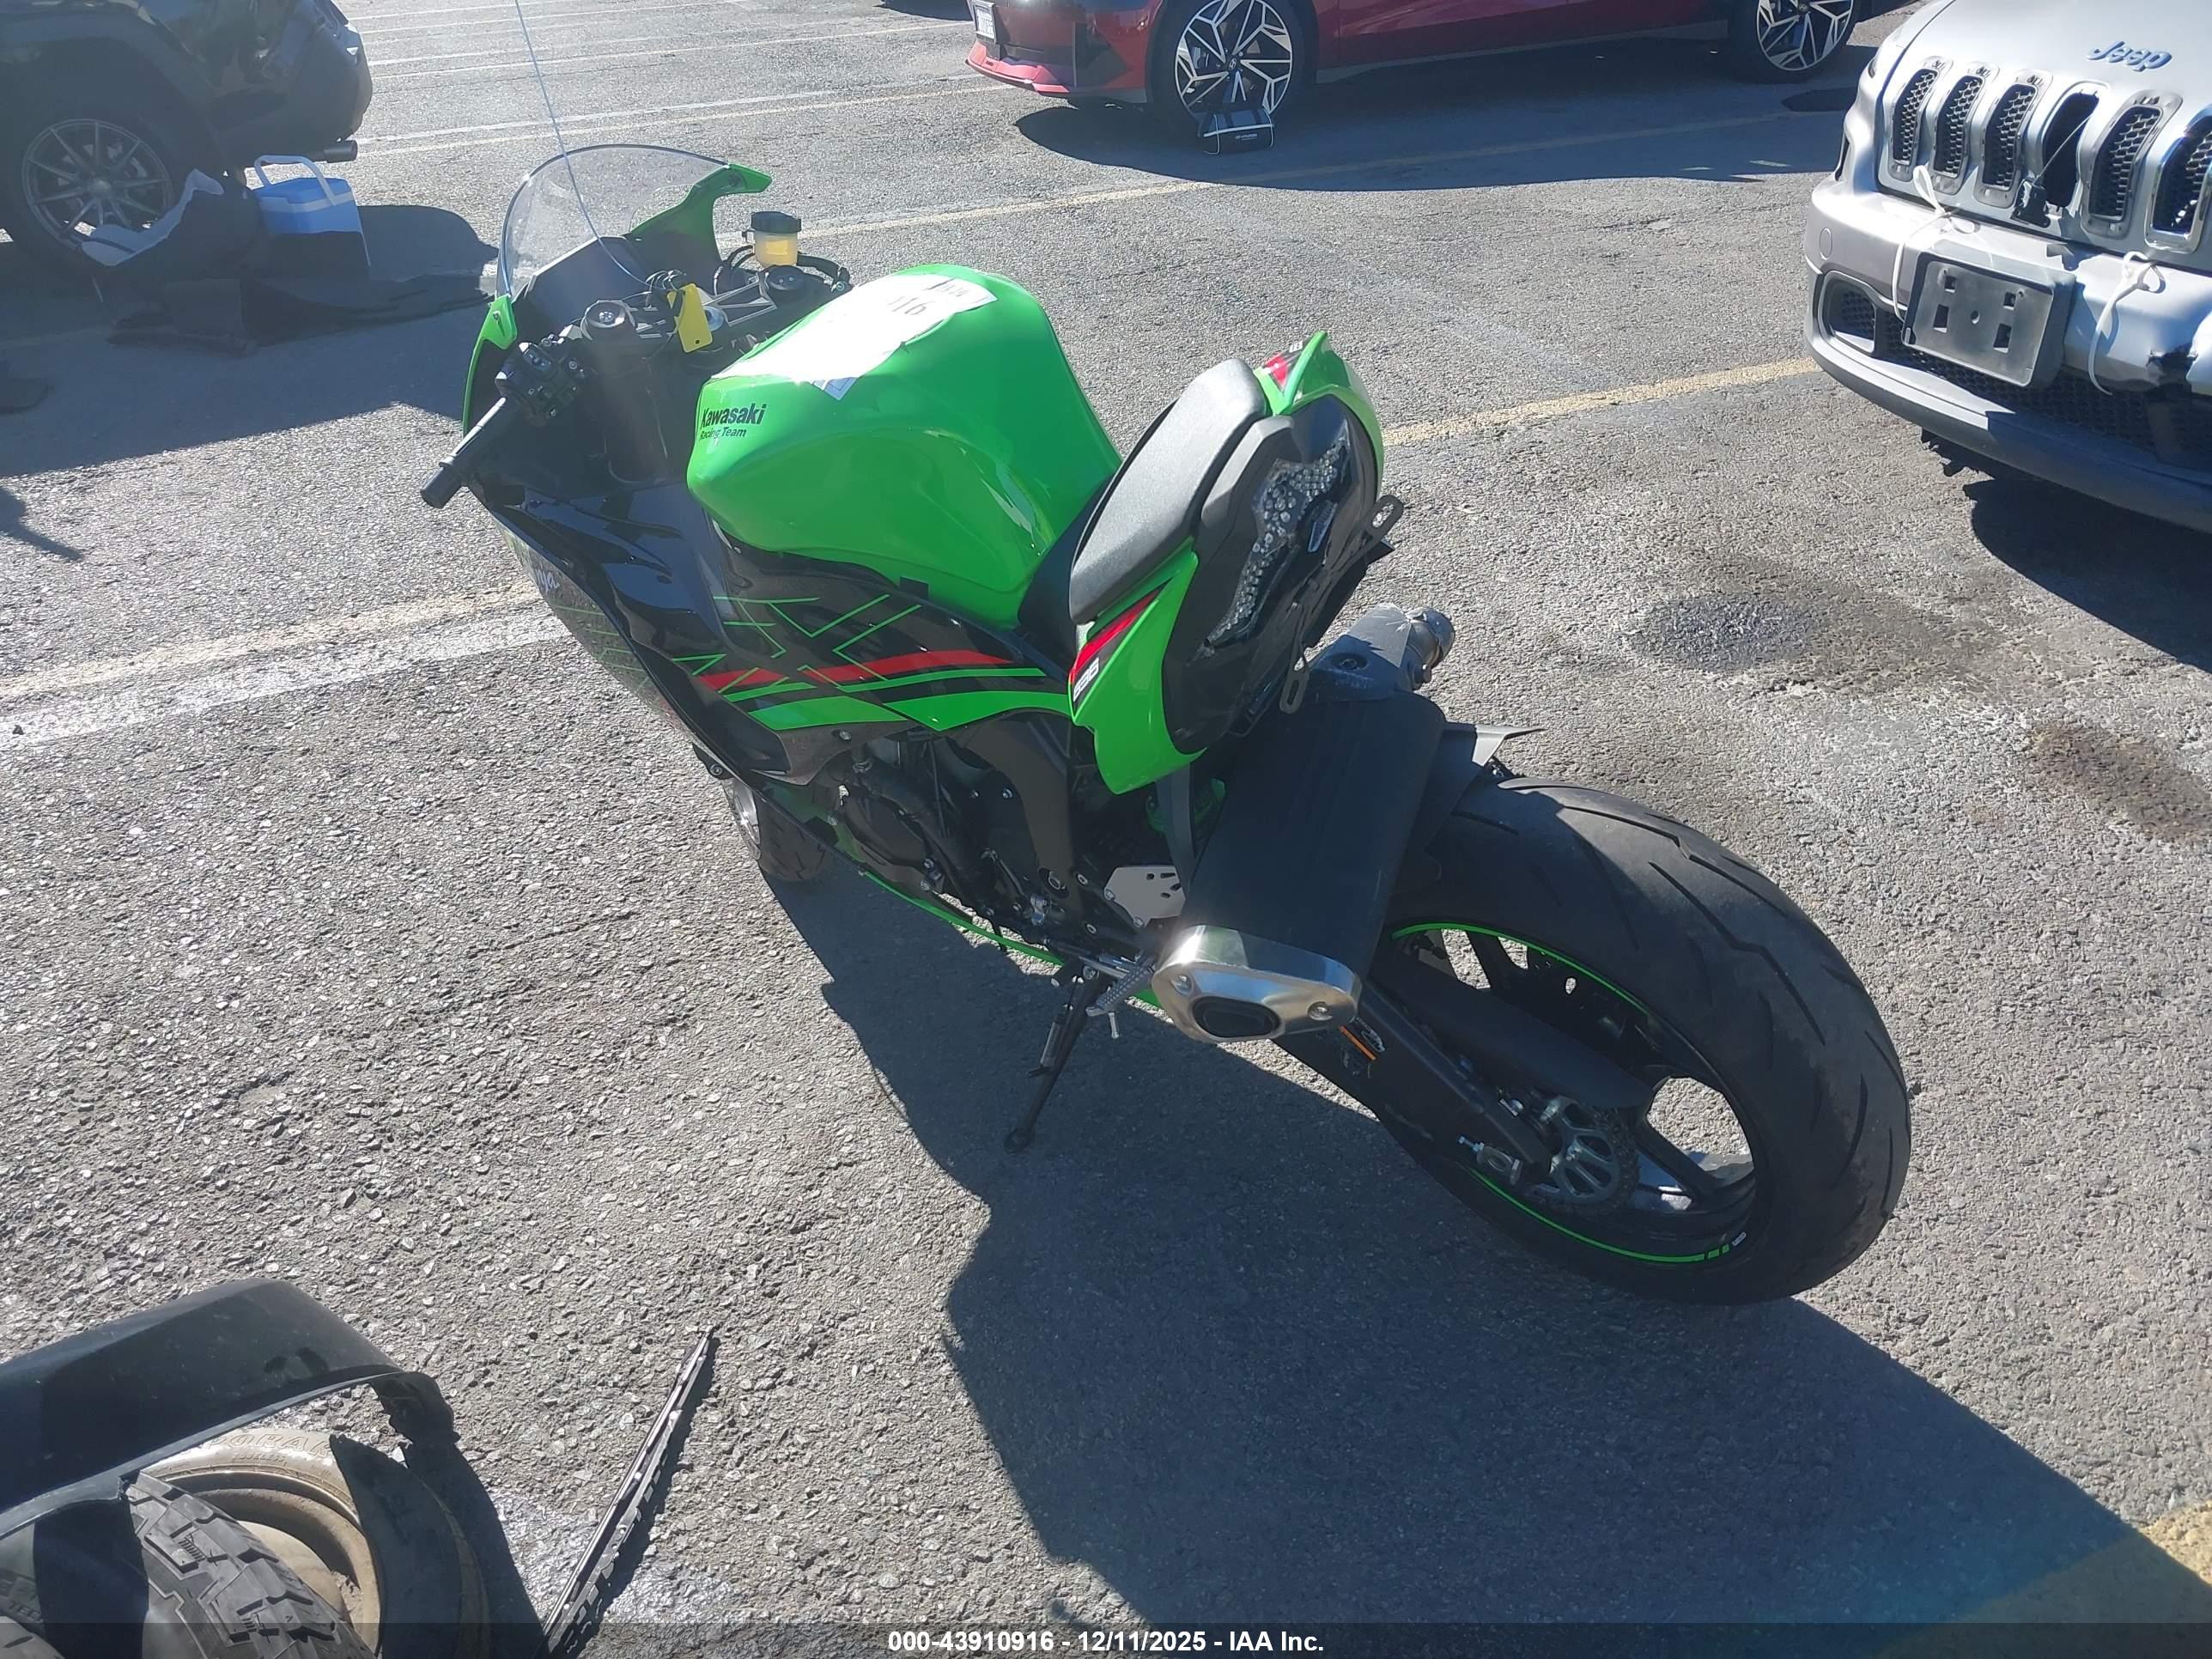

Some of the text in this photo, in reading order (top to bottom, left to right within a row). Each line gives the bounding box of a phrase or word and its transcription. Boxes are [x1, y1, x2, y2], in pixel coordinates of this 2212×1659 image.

[2087, 40, 2172, 72] Jeep
[701, 402, 768, 428] Kawasaki
[721, 426, 747, 438] Team
[1073, 657, 1100, 702] 636
